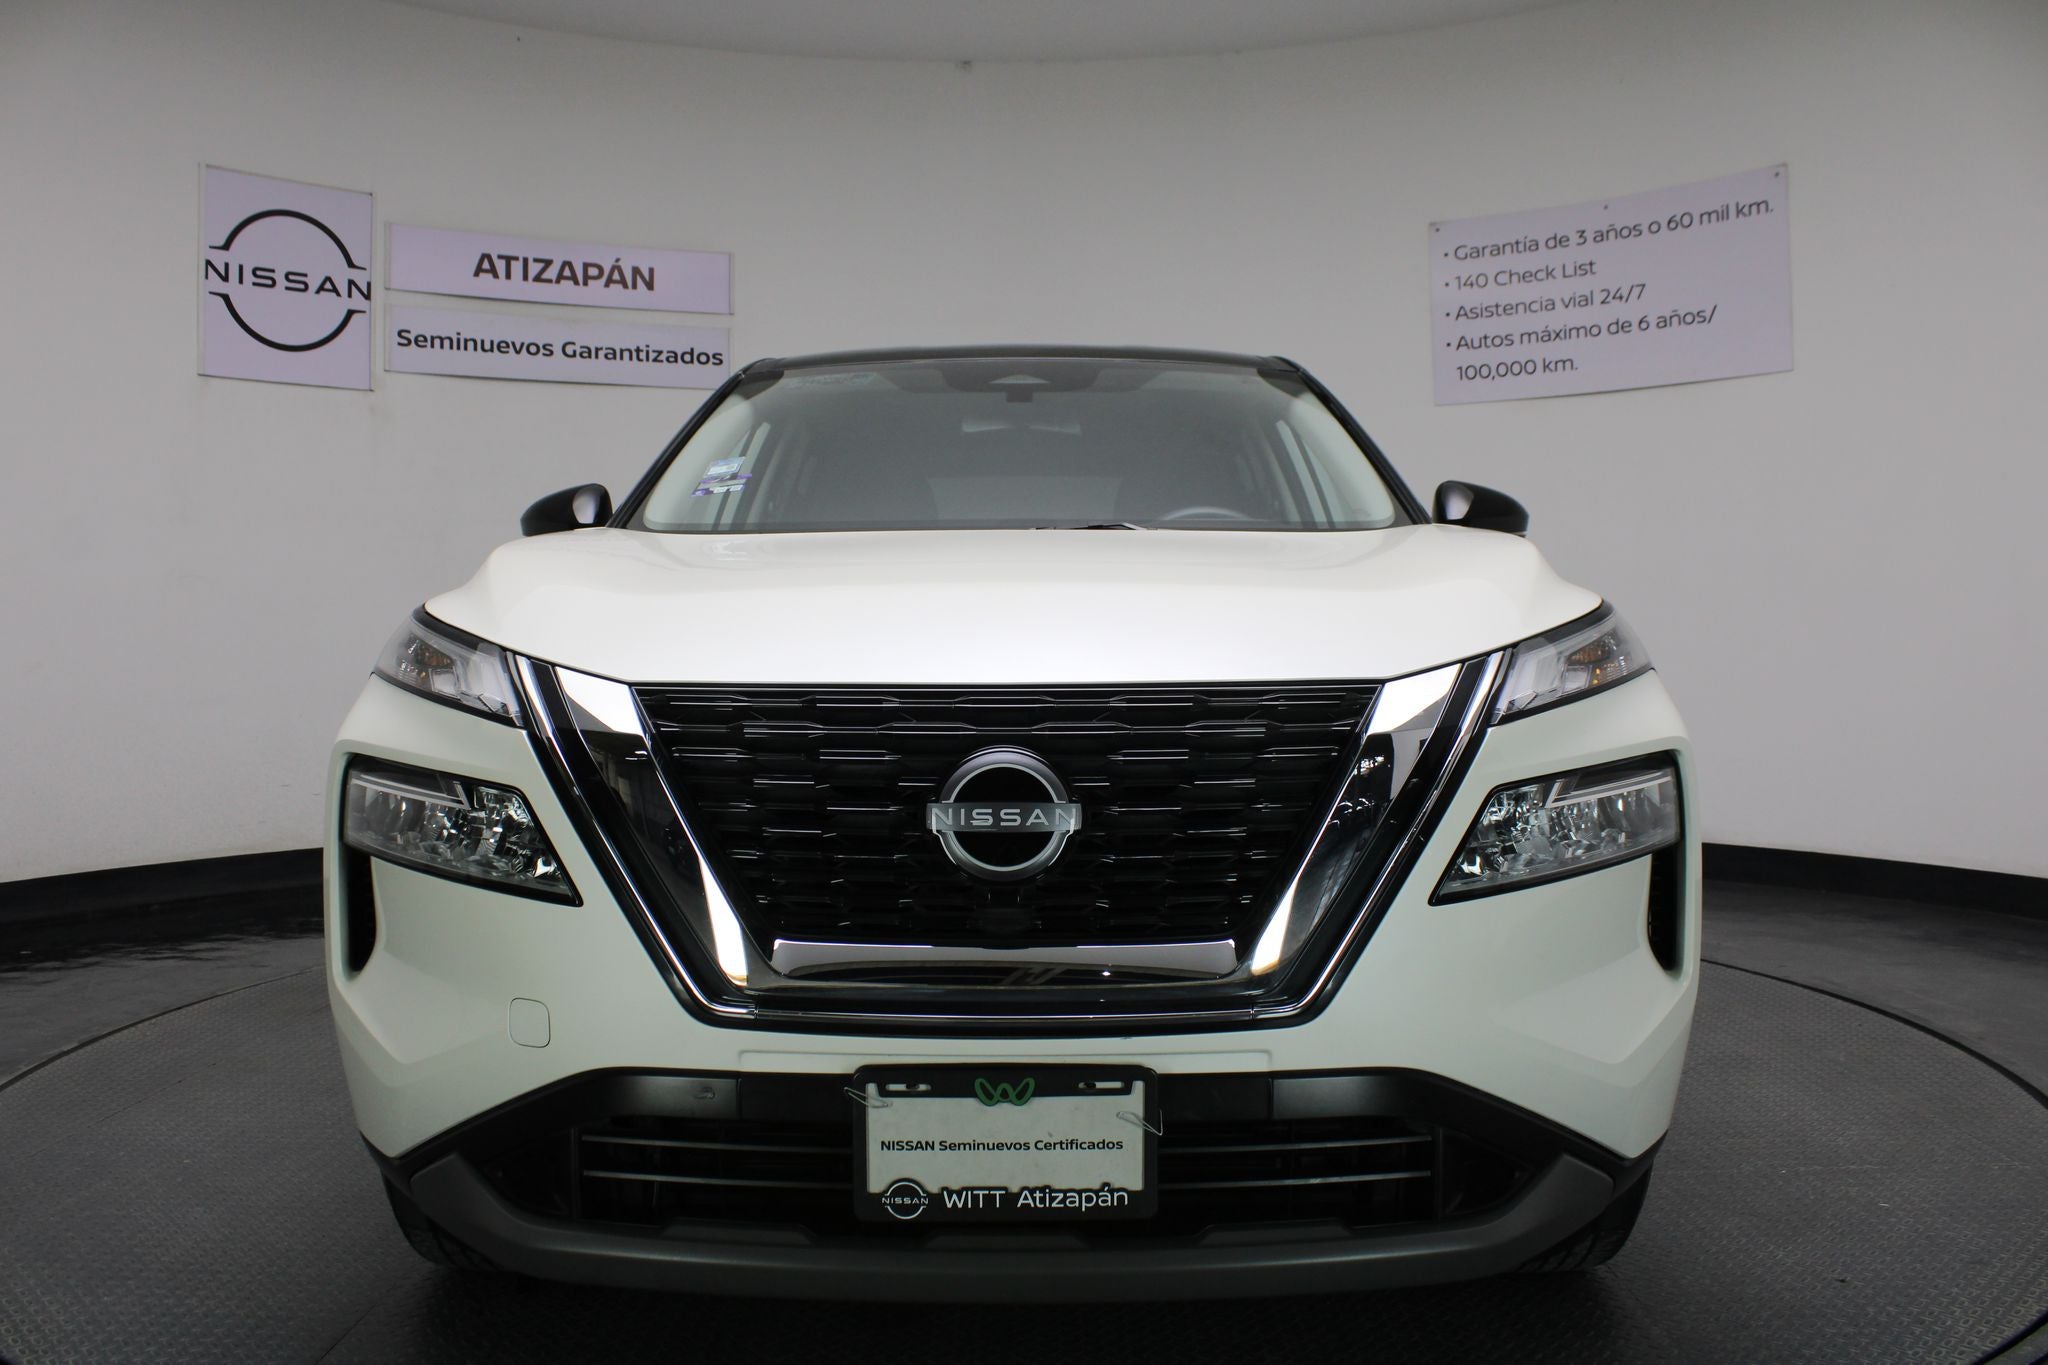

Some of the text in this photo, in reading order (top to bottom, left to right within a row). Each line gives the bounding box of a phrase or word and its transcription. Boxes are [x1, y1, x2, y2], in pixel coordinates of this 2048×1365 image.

[1454, 199, 1775, 262] Garantía de 3 años o 60 mil km.
[204, 258, 372, 301] NISSAN
[473, 252, 655, 291] ATIZAPÁN
[1455, 259, 1597, 290] 140 Check List
[1455, 283, 1647, 321] Asistencia vial 24/7
[1456, 304, 1719, 351] Autos máximo de 6 años/
[396, 328, 724, 367] Seminuevos Garantizados
[1456, 357, 1579, 382] 100,000 km.
[932, 808, 1075, 826] NISSAN
[880, 1138, 1124, 1151] NISSAN Seminuevos Certificados
[882, 1197, 928, 1205] NISSAN
[943, 1186, 1128, 1211] WITT Atizapán
